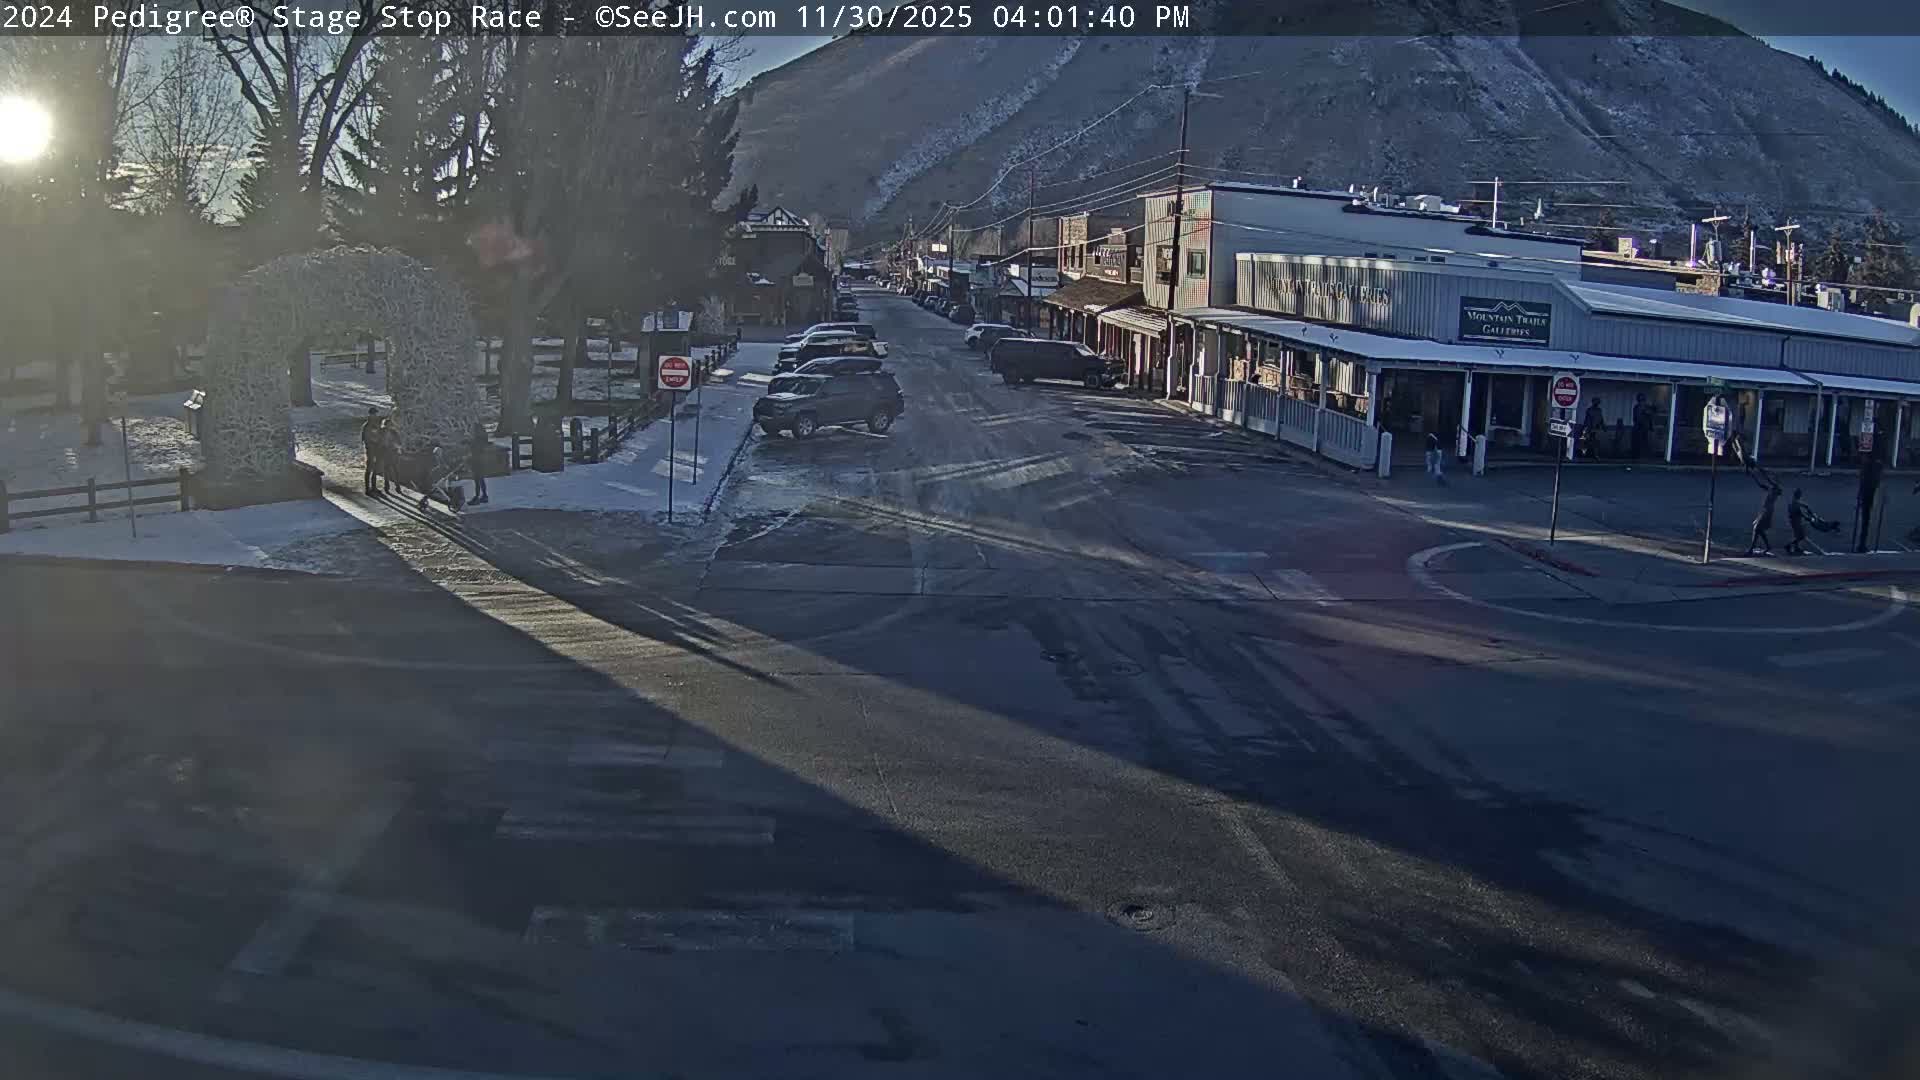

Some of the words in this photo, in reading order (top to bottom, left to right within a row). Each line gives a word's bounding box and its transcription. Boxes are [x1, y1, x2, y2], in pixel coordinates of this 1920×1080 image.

[1467, 310, 1514, 323] MOUNTAIN
[1515, 314, 1546, 327] TRAILS
[1482, 324, 1530, 336] GALLERIES
